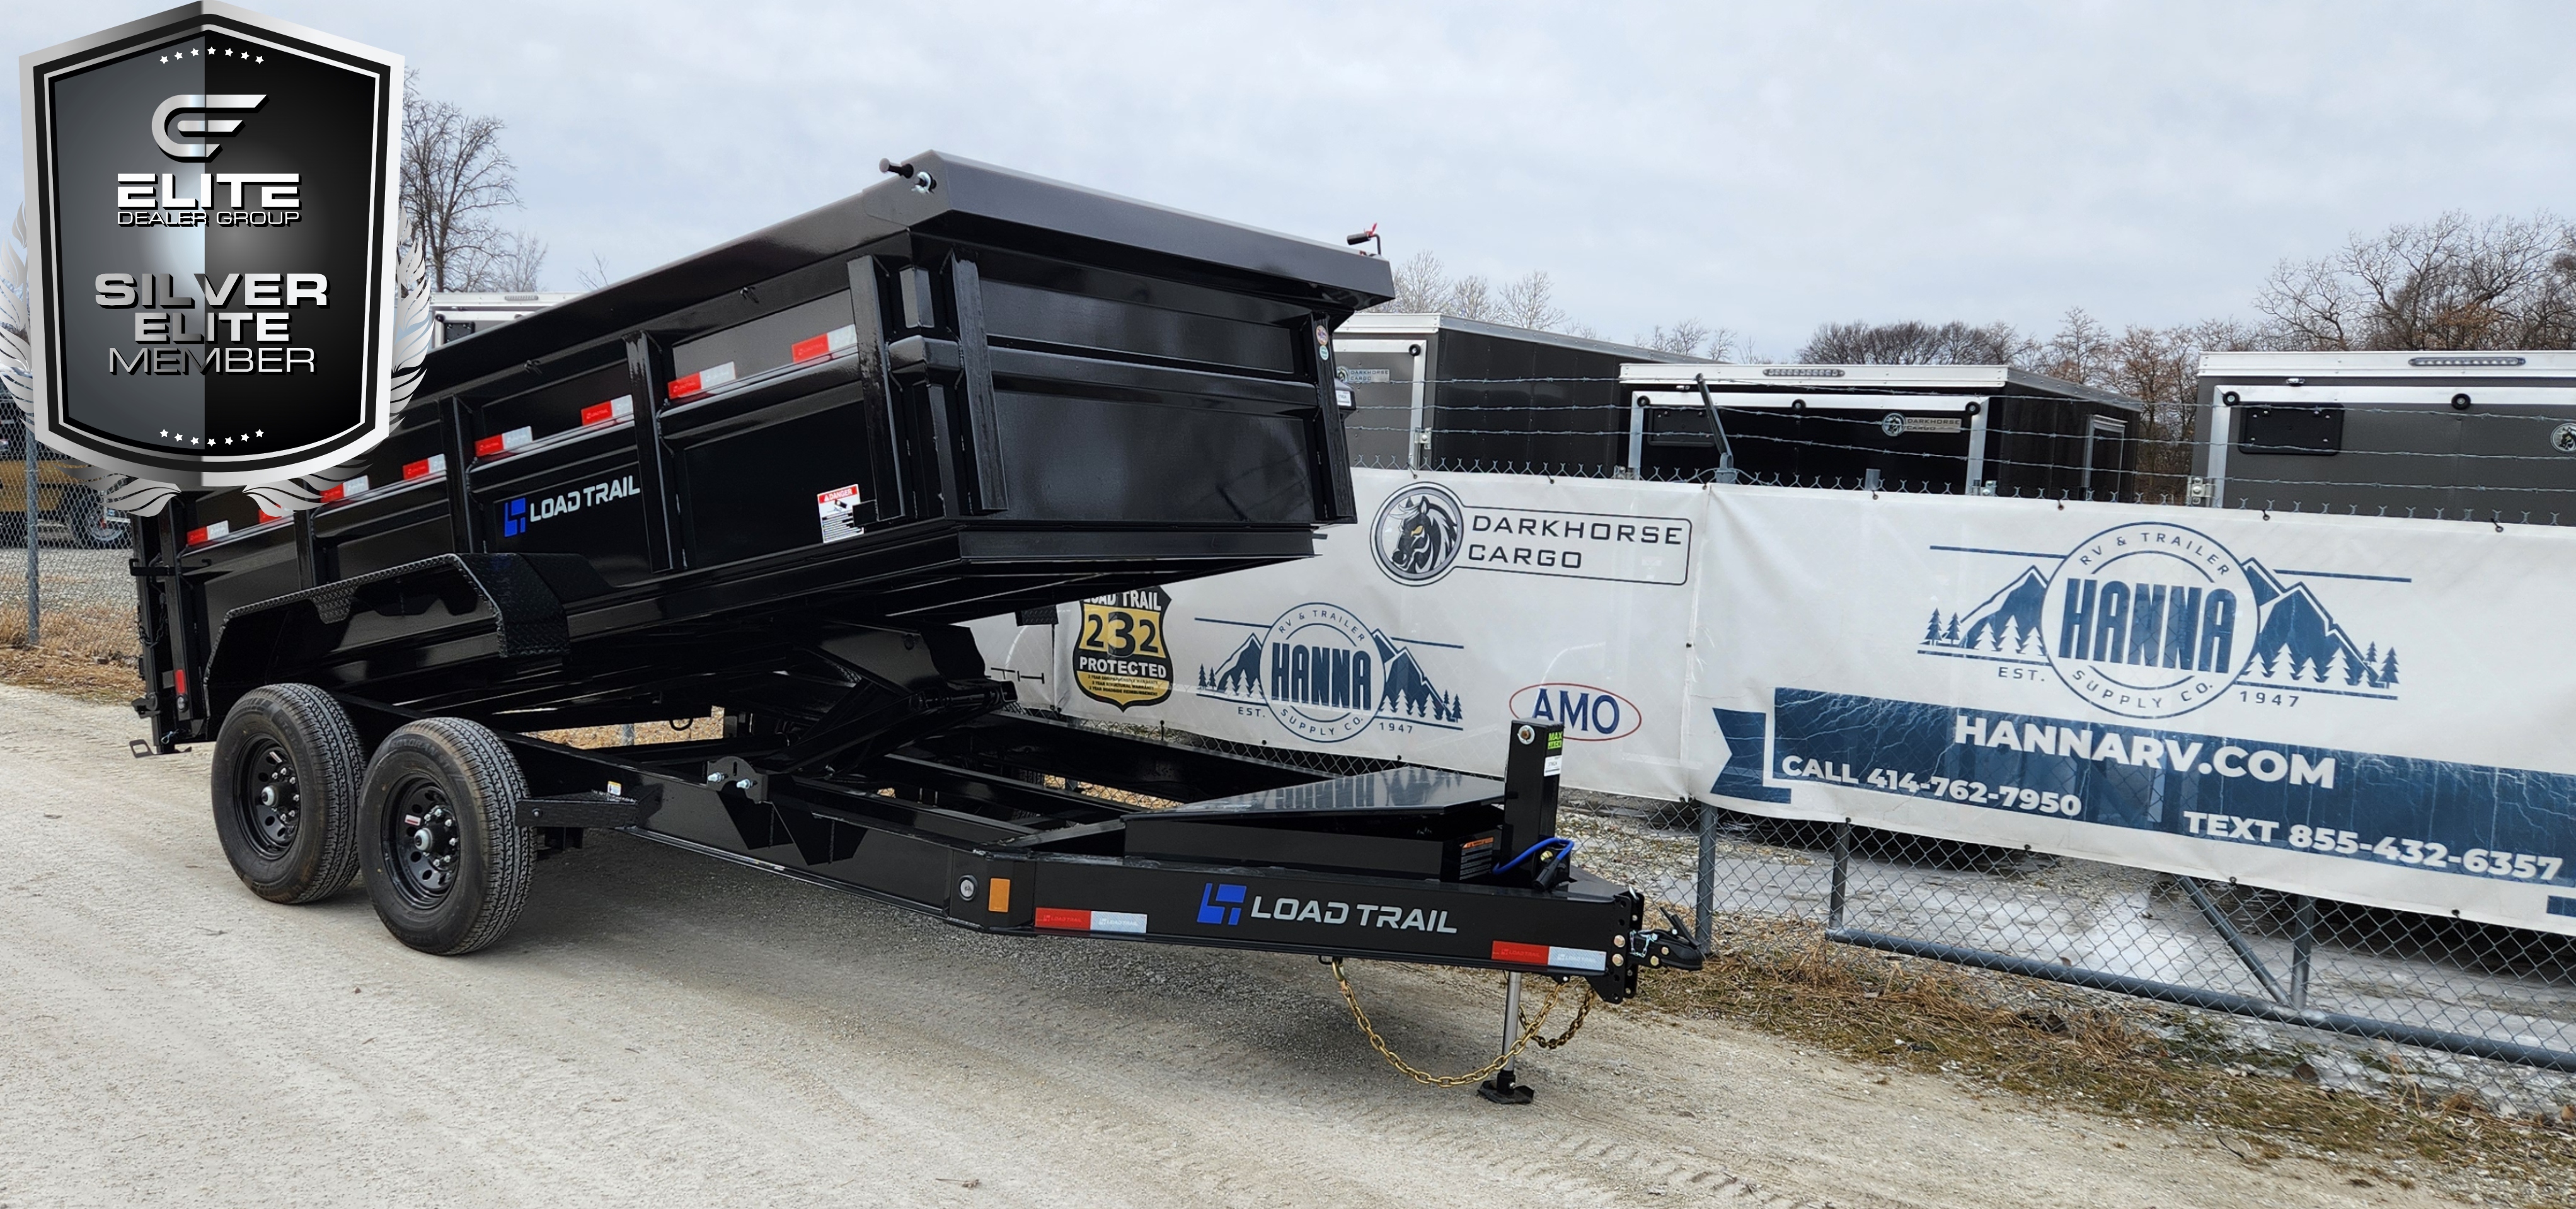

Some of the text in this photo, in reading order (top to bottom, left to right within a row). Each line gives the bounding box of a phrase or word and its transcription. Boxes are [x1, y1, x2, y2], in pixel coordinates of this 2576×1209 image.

[530, 475, 640, 523] LOAD TRAIL
[829, 489, 852, 500] DANGER
[1472, 515, 1682, 545] DARKHORSE
[1468, 545, 1582, 569] CARGO
[2079, 533, 2229, 576] RV & TRAILER
[1121, 589, 1161, 611] TRAIL
[1086, 611, 1159, 657] 232
[1278, 610, 1366, 642] RV & TRAILER
[2058, 577, 2237, 674] HANNA
[1079, 656, 1166, 678] PROTECTED
[1271, 642, 1372, 711] HANNA
[1998, 666, 2045, 682] EST.
[2072, 669, 2213, 709] SUPPLY CO.
[2240, 691, 2299, 707] 1947
[1238, 706, 1265, 718] EST.
[1280, 708, 1364, 736] SUPPLY CO.
[1532, 688, 1619, 734] AMO
[1379, 722, 1414, 734] 1947
[1548, 731, 1563, 741] MAX
[1956, 714, 2337, 790] HANNARV.COM
[1781, 756, 2082, 817] CALL 414-762-7950
[2183, 811, 2563, 881] TEXT 855-432-6357
[1251, 896, 1457, 934] LOAD TRAIL
